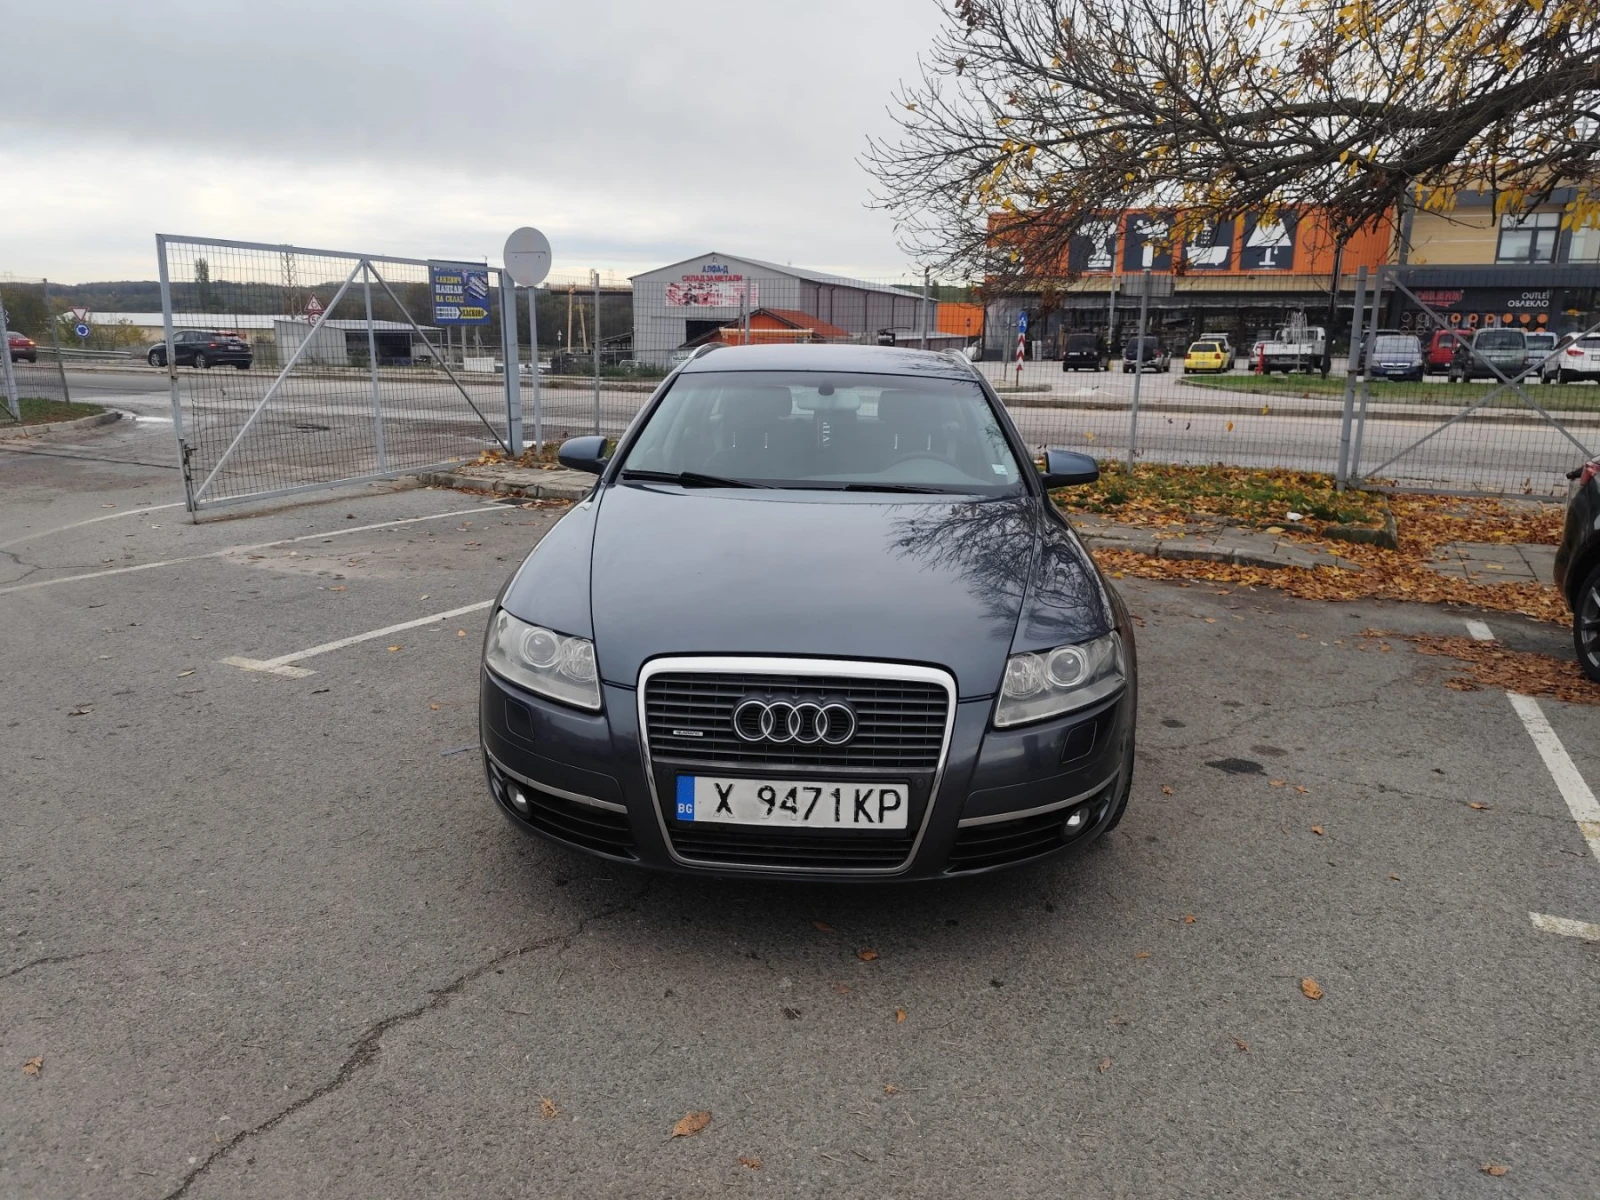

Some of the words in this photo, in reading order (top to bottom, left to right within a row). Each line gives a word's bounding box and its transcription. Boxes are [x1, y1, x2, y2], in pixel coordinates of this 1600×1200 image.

[702, 265, 729, 274] АЛФА-Д
[681, 274, 704, 283] СКЛАД
[715, 274, 743, 282] МЕТАЛИ
[677, 803, 693, 814] BG
